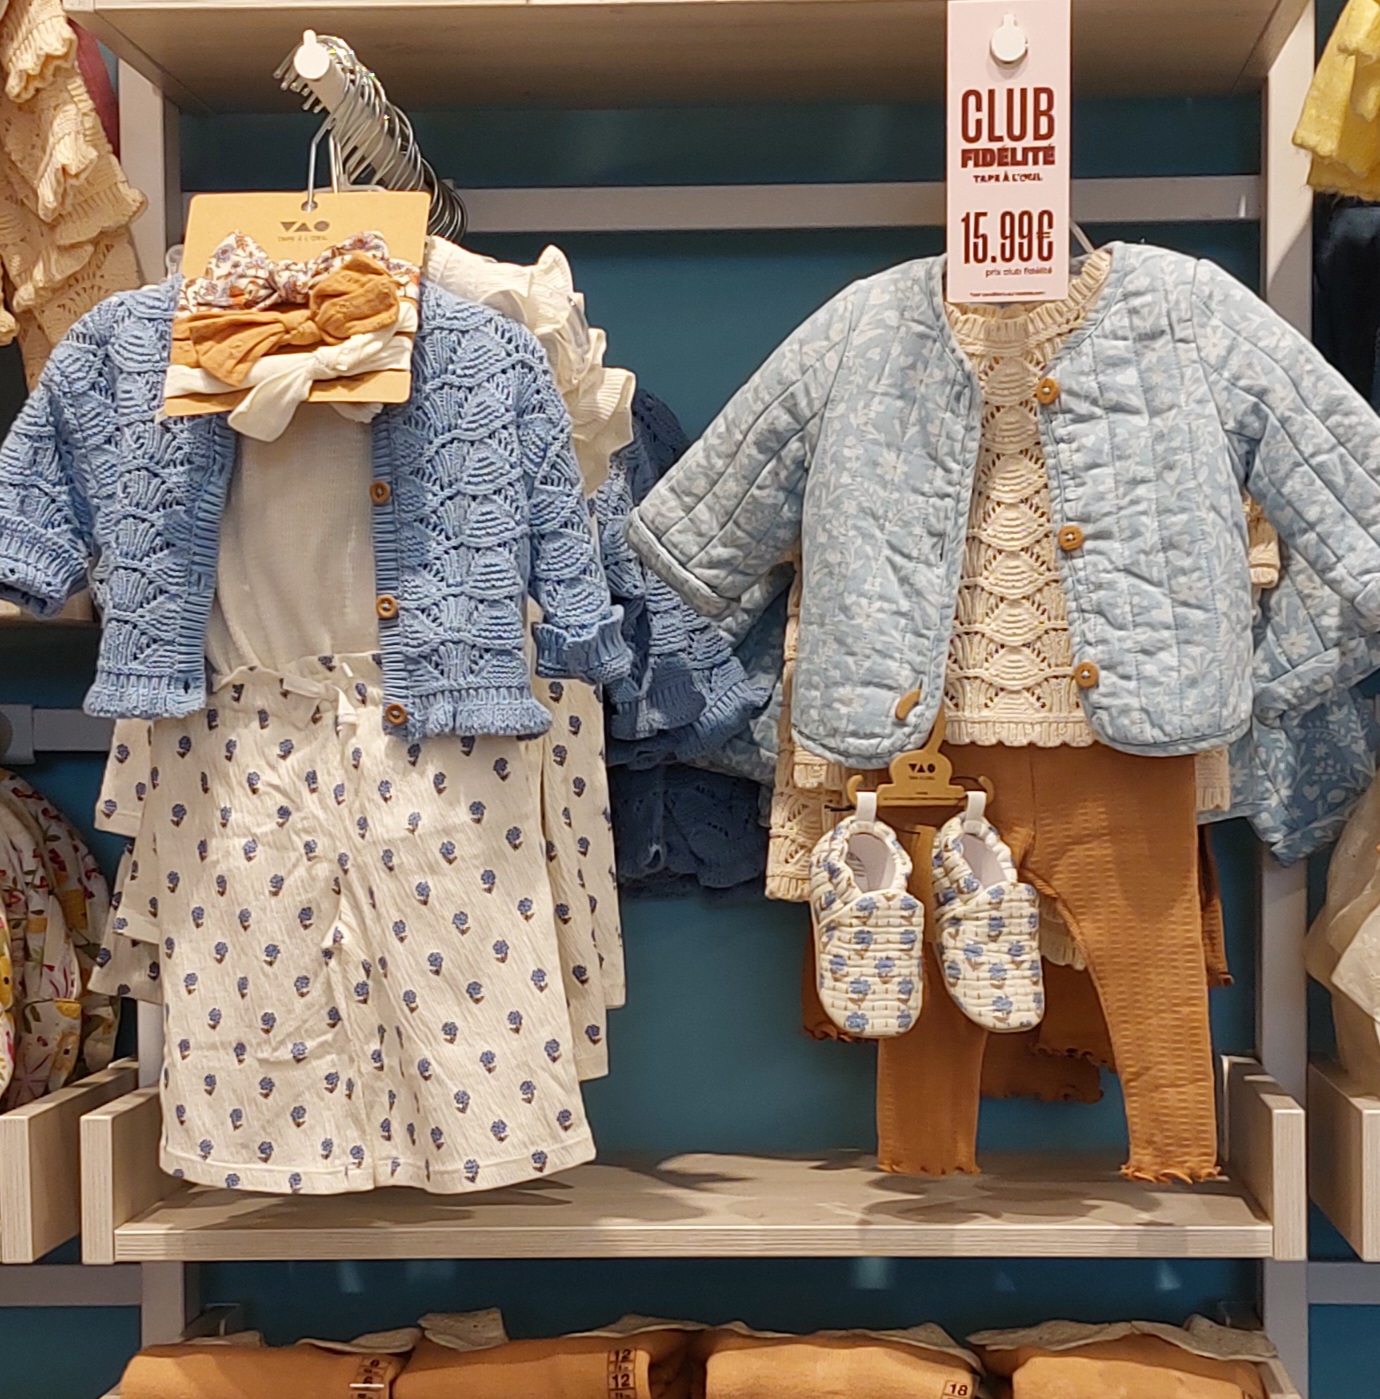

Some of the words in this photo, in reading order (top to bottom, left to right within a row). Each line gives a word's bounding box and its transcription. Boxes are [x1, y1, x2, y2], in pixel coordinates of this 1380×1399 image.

[961, 87, 1055, 144] CLUB
[961, 143, 1055, 168] FIDÉLITÉ
[961, 210, 1053, 264] 15.99€
[612, 1373, 630, 1388] 12
[949, 1383, 968, 1396] 18
